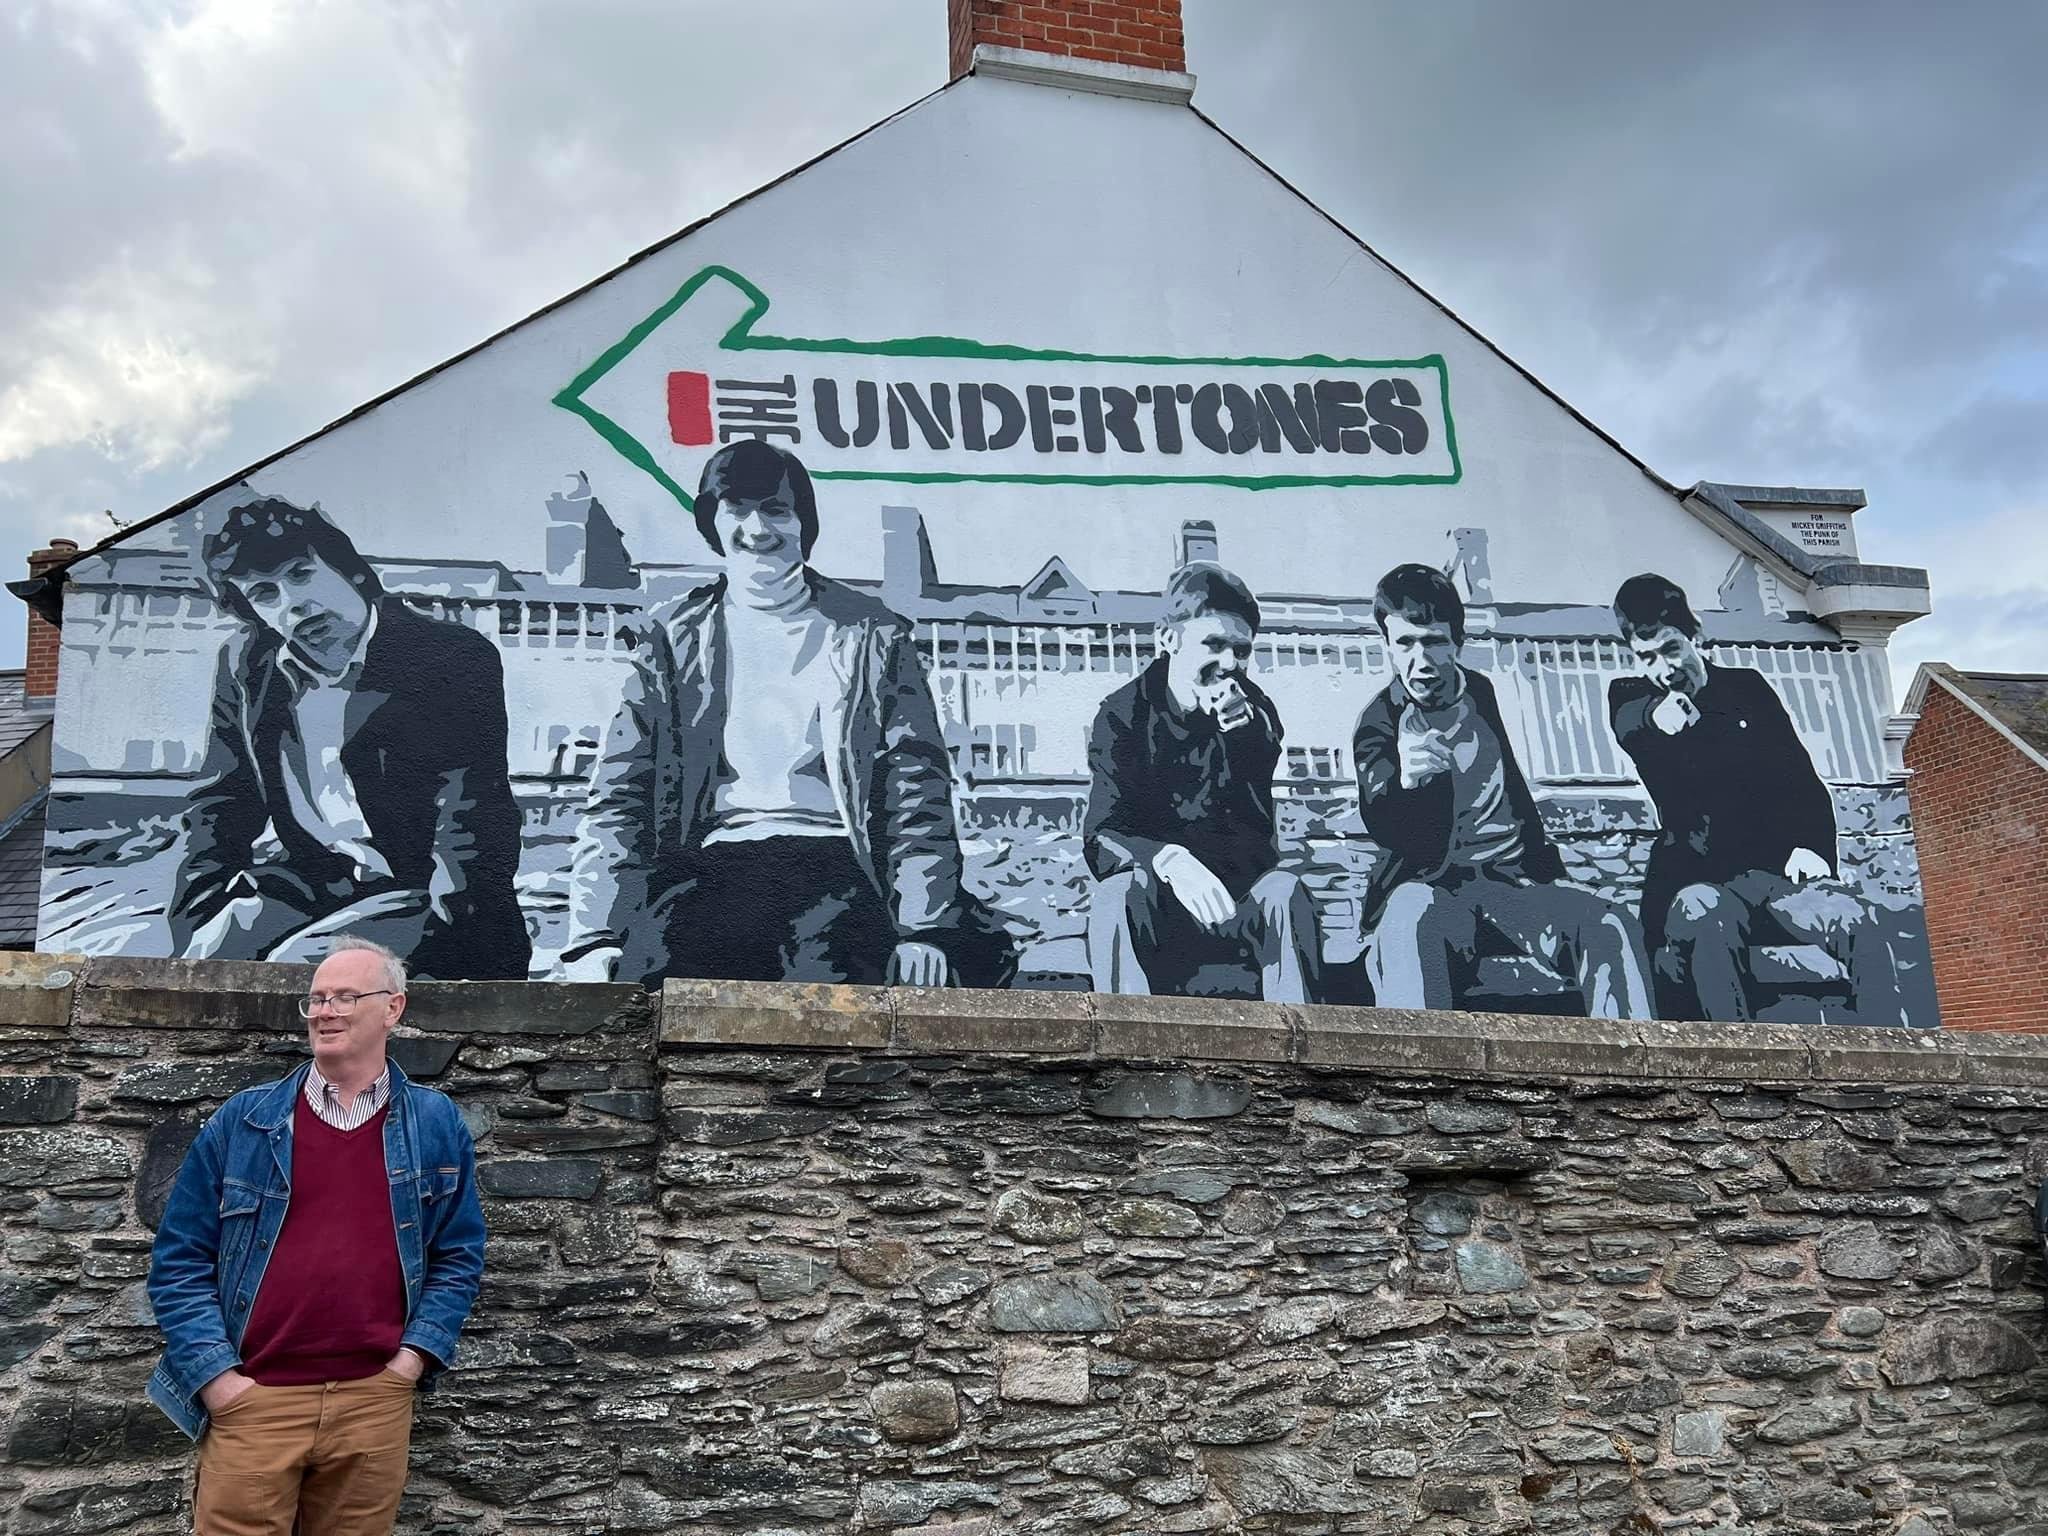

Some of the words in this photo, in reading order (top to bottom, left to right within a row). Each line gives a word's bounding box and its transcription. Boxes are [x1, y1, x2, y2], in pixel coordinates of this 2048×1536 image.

[716, 374, 801, 444] THE
[812, 378, 1429, 455] UNDERTONES
[1815, 522, 1847, 530] GRIFFITHS
